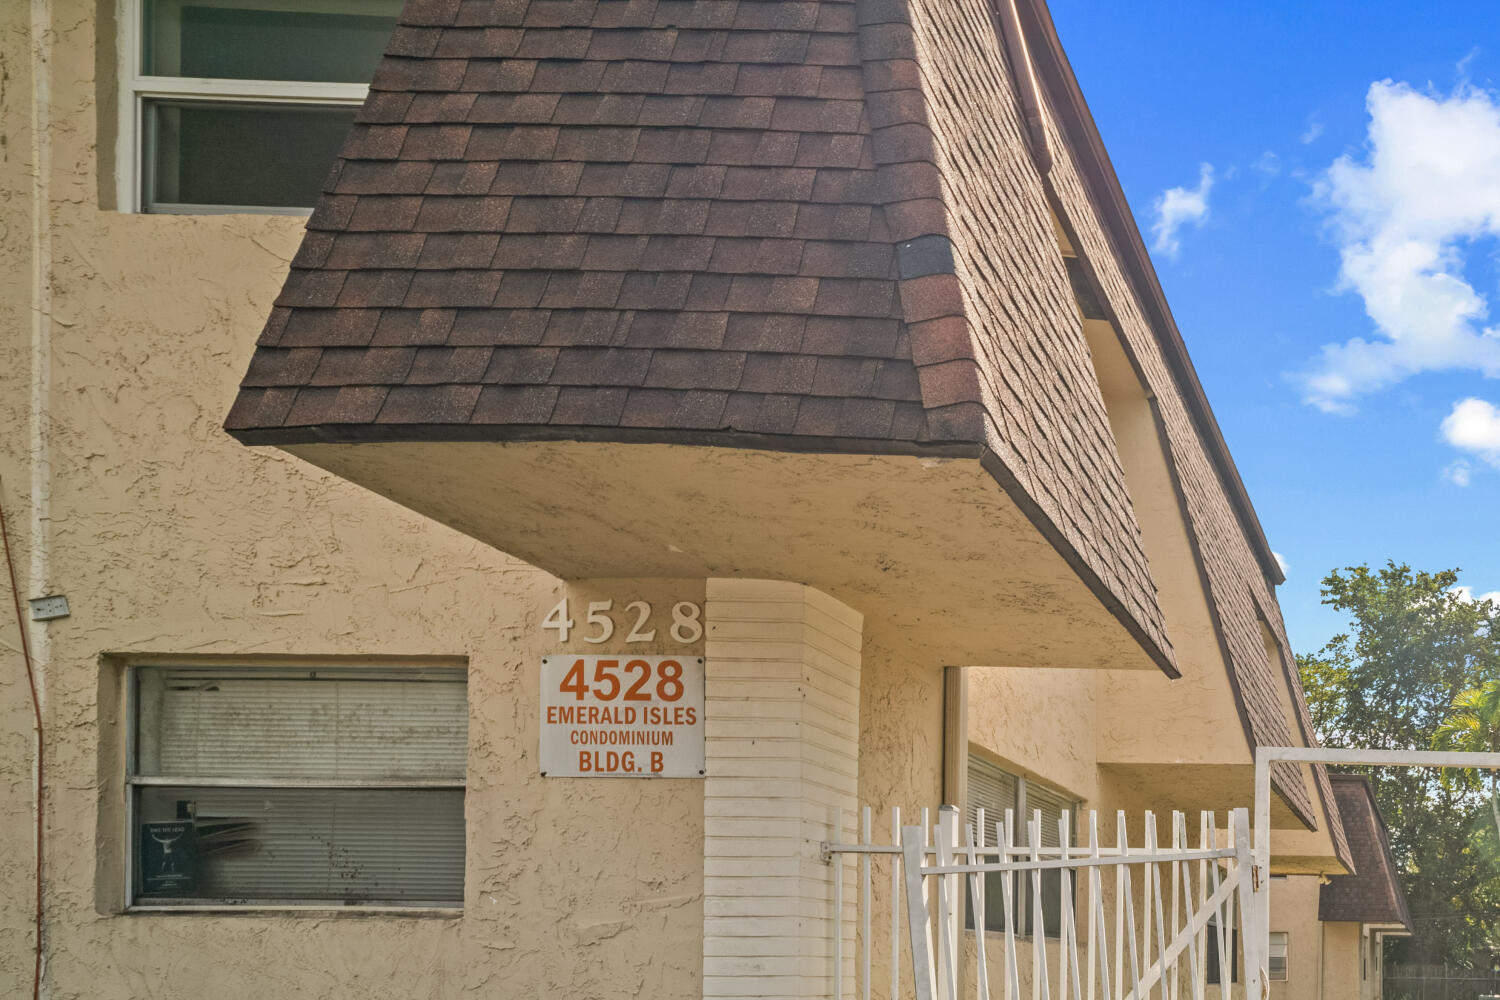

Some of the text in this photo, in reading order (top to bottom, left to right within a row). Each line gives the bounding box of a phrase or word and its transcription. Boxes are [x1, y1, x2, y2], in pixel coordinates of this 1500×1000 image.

[540, 598, 703, 644] 4528
[559, 659, 685, 702] 4528
[546, 706, 697, 726] EMERALD ISLES
[570, 730, 673, 746] CONDOMINIUM
[579, 751, 664, 773] BLDG. B
